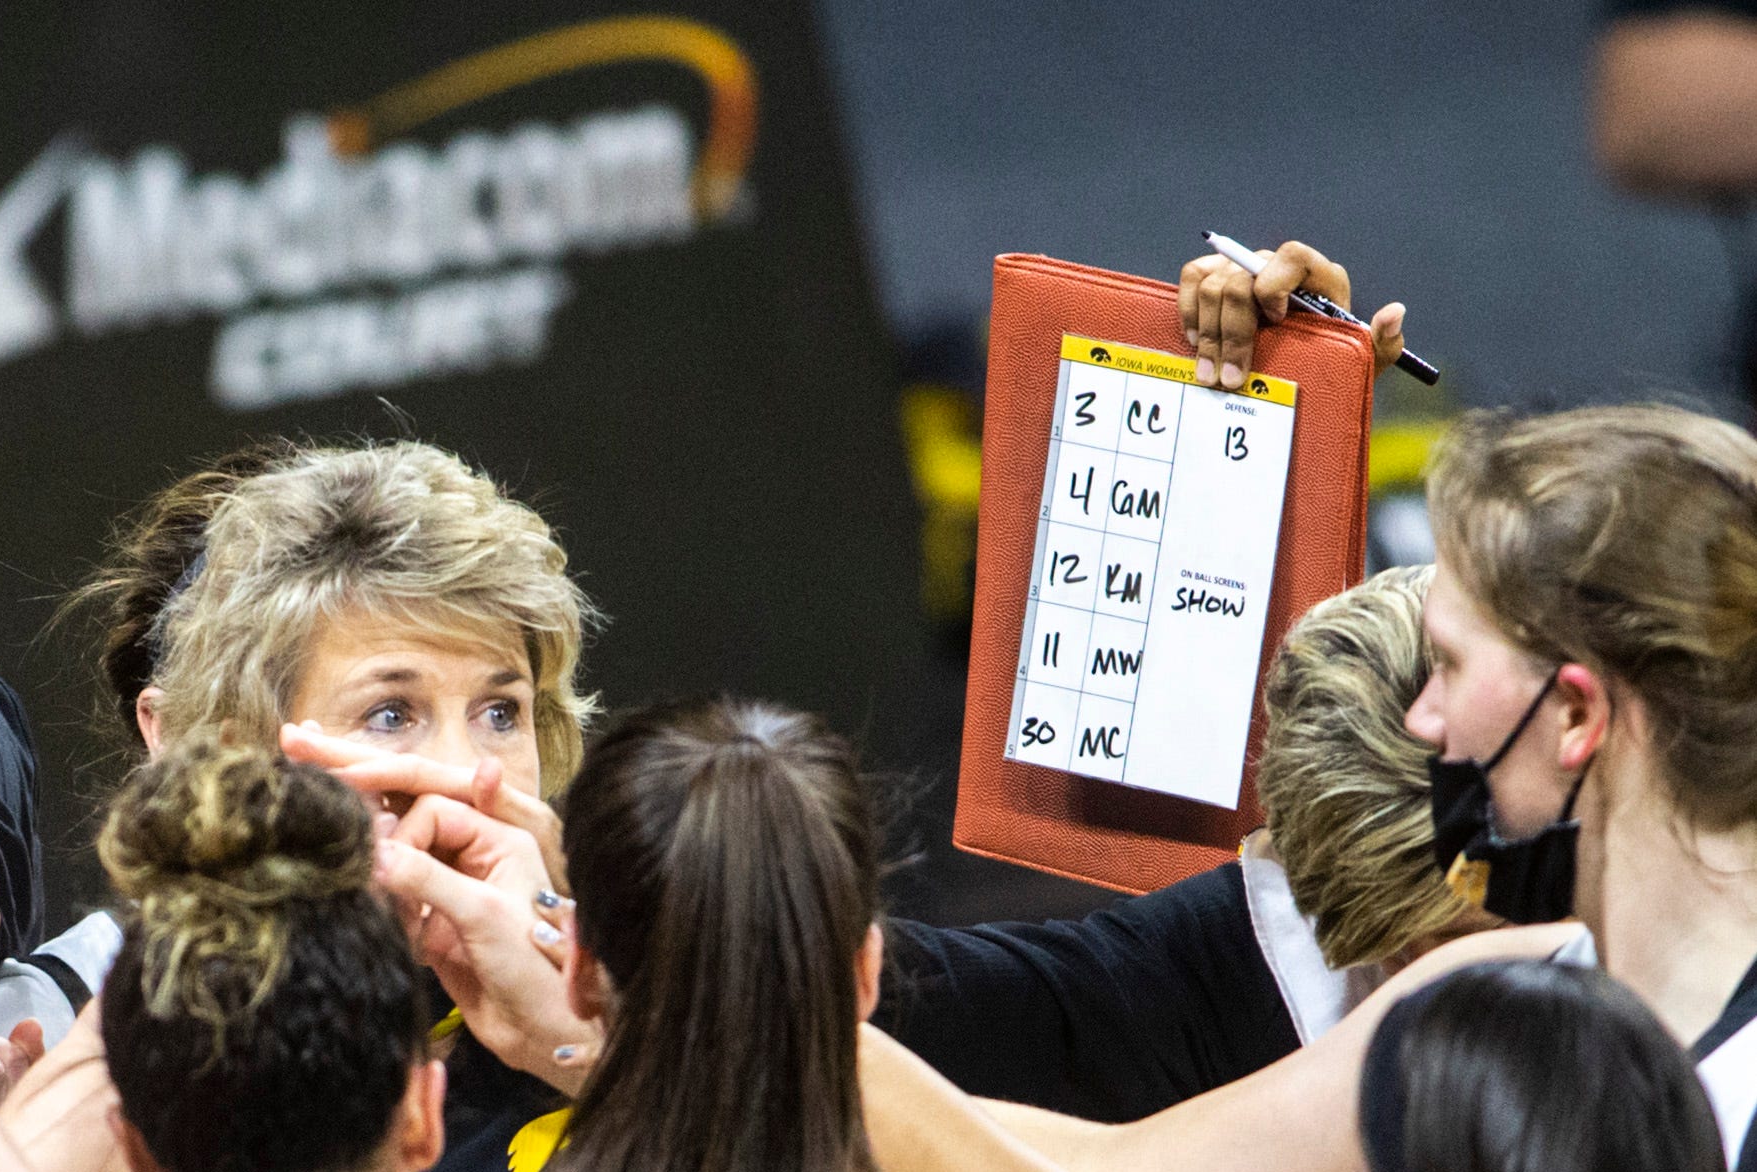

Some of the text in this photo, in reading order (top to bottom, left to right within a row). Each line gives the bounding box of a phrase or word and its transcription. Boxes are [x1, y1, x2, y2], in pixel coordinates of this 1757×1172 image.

[65, 104, 697, 335] Mediacom
[1115, 356, 1195, 381] IOWA WOMEN'S
[1074, 391, 1166, 435] 3 CC
[1054, 425, 1061, 437] 1
[1224, 426, 1249, 461] 13
[1069, 466, 1095, 516] 4
[1042, 506, 1049, 517] 2
[1031, 585, 1039, 597] 3
[1050, 550, 1143, 605] 12 KM
[1180, 568, 1193, 579] ON
[1194, 572, 1212, 584] BALL
[1171, 586, 1246, 618] SHOW
[1042, 631, 1144, 676] 11 MW
[1019, 665, 1027, 676] 4
[1007, 744, 1015, 756] 5
[1021, 716, 1125, 760] 30 MC
